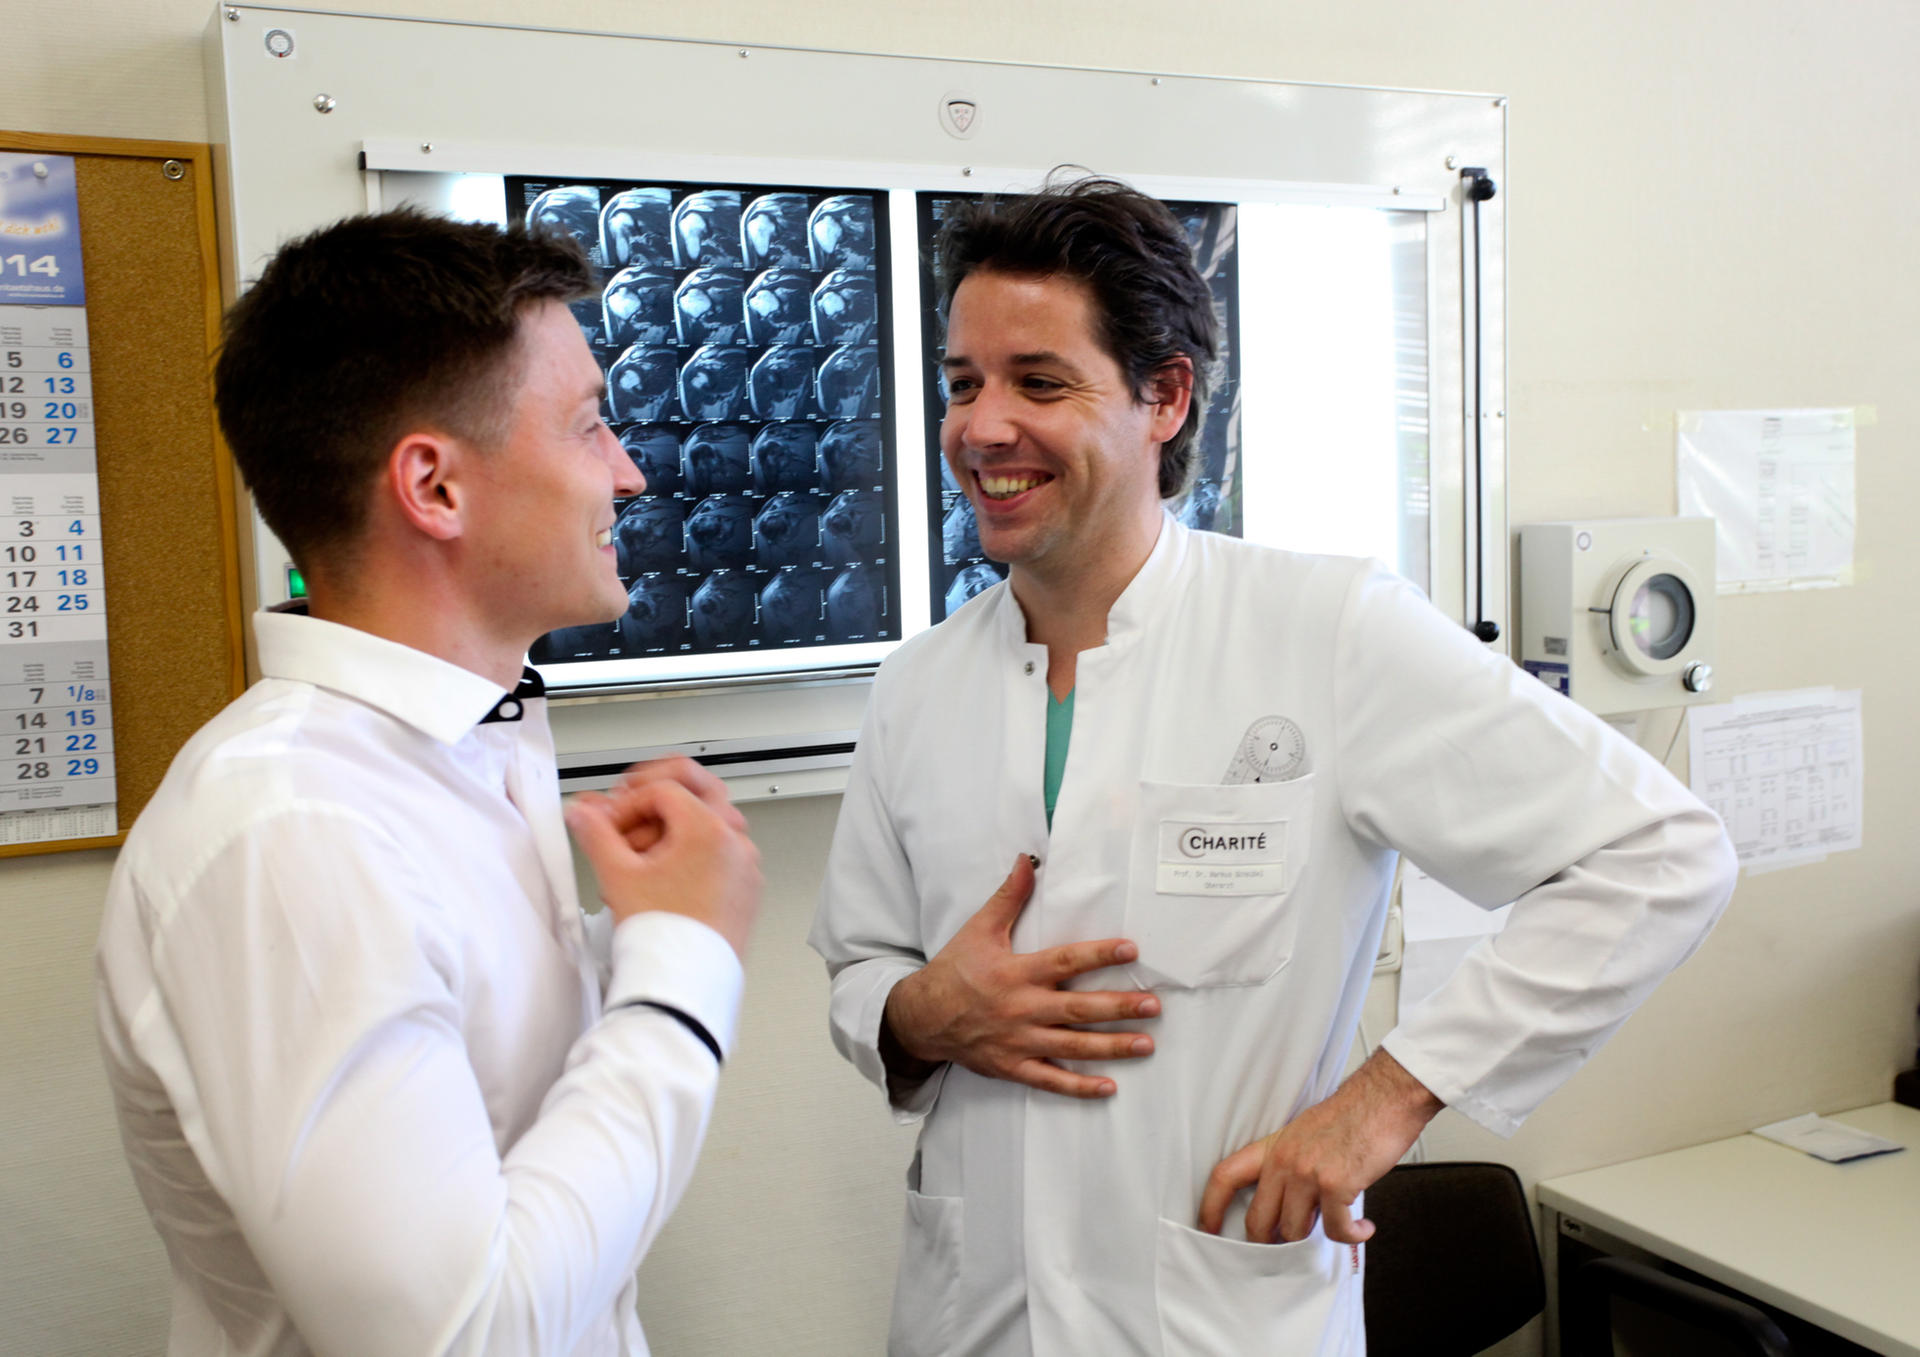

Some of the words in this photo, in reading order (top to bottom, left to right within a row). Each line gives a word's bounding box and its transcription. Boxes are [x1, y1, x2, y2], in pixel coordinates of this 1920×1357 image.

[0, 253, 60, 277] 14
[7, 351, 23, 368] 5
[58, 352, 73, 369] 6
[44, 377, 75, 394] 13
[0, 402, 26, 419] 19
[45, 402, 76, 419] 20
[0, 427, 29, 445] 26
[46, 427, 77, 444] 27
[19, 520, 34, 537] 3
[68, 520, 85, 536] 4
[6, 545, 36, 562] 10
[56, 544, 83, 561] 11
[7, 571, 37, 588] 17
[58, 569, 87, 586] 18
[7, 596, 39, 613] 24
[57, 594, 89, 611] 25
[8, 621, 38, 638] 31
[29, 687, 44, 704] 7
[67, 684, 95, 702] 1/8
[16, 712, 48, 730] 14
[65, 709, 96, 727] 15
[16, 737, 45, 755] 21
[65, 734, 98, 751] 22
[17, 762, 50, 780] 28
[66, 758, 99, 776] 29
[1188, 831, 1267, 851] CHARITÉ
